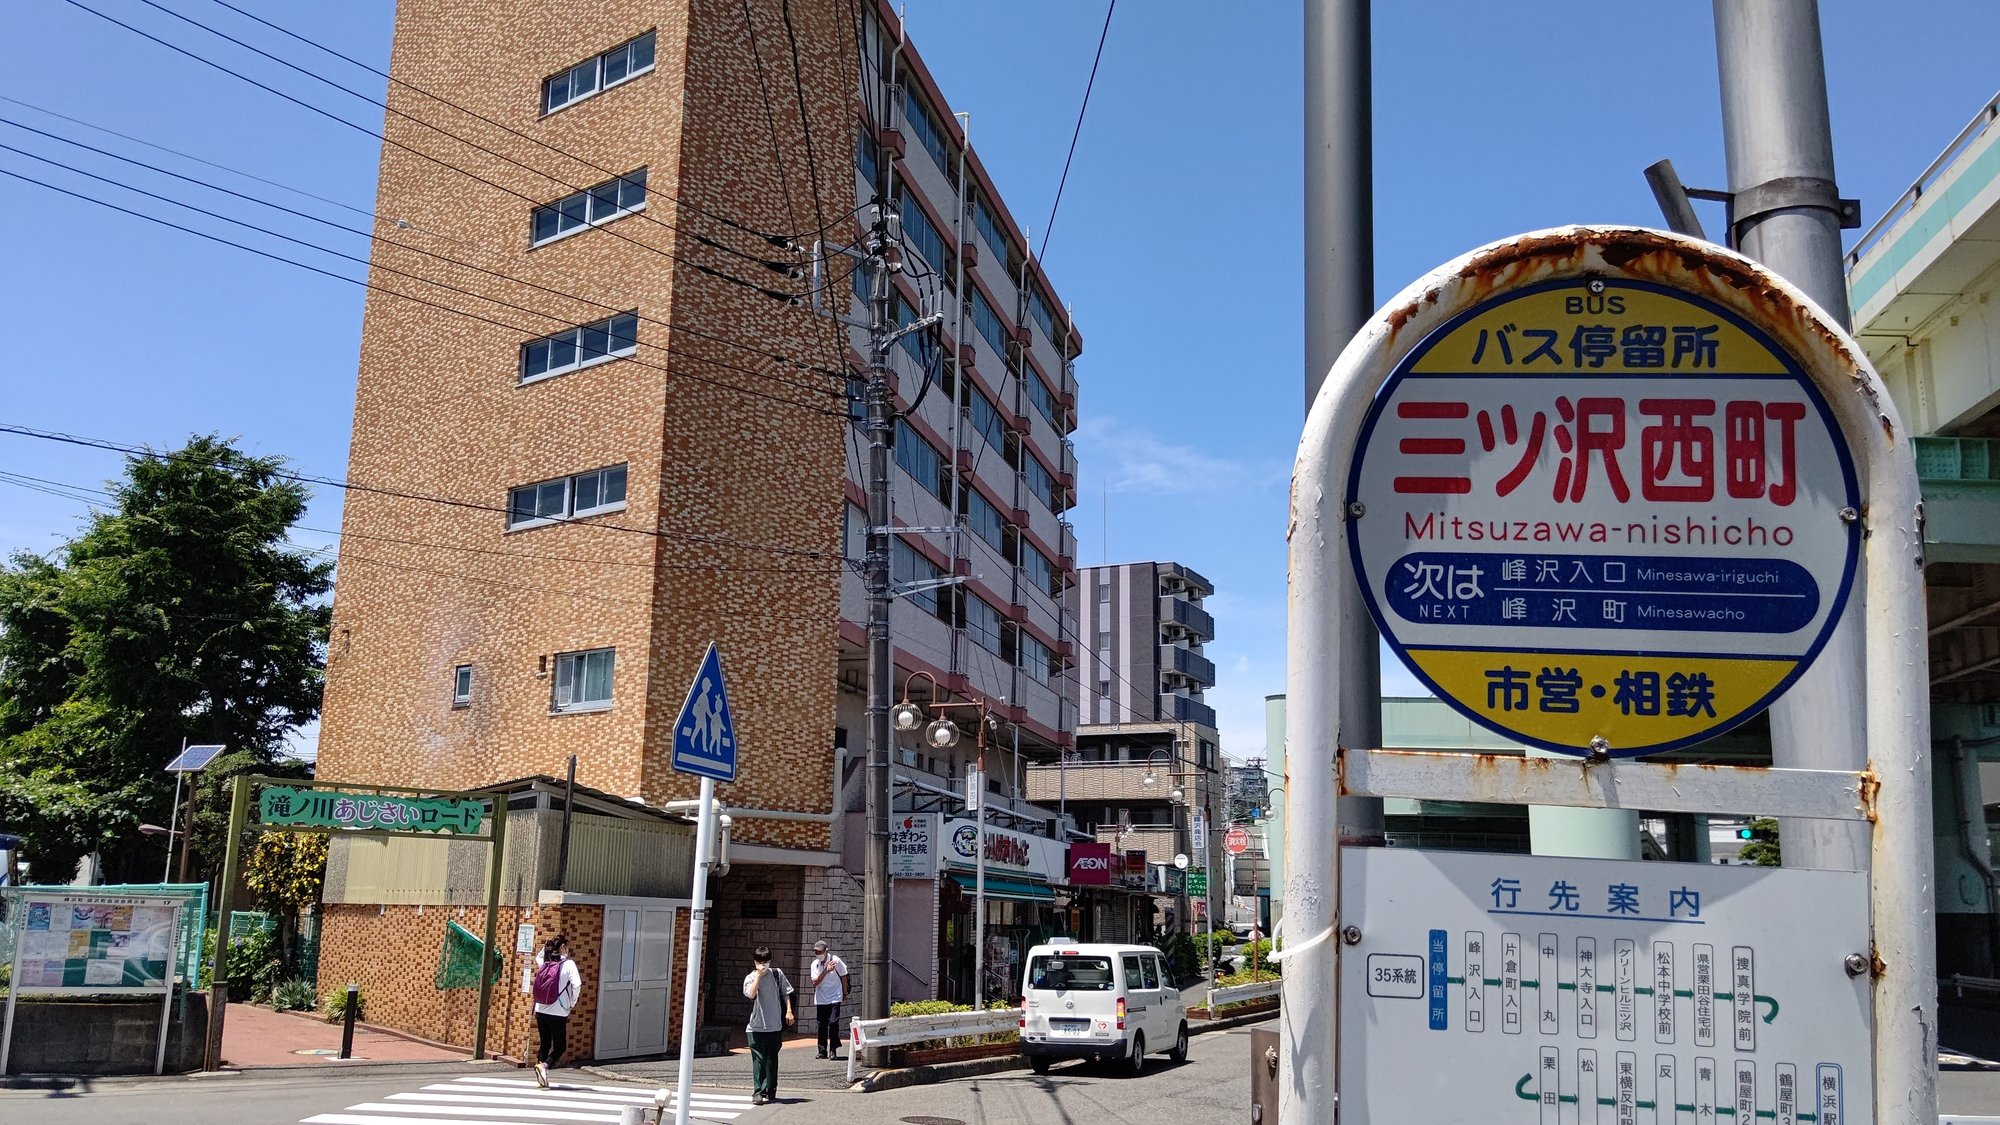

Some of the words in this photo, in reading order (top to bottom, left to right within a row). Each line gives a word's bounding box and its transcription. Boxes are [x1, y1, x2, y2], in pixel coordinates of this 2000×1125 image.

[1565, 295, 1626, 315] BUS
[1471, 323, 1719, 369] バス停留所
[1393, 395, 1806, 506] 三ツ沢西町
[1405, 511, 1794, 546] Mitsuzawa-nishicho
[1403, 560, 1484, 600] 次は
[1502, 559, 1626, 583] 峰沢入口
[1637, 567, 1779, 584] Minesawa-iriguchi
[1419, 604, 1470, 619] NEXT
[1502, 597, 1628, 623] 峰沢町
[1637, 605, 1745, 620] Minesawacho
[1484, 665, 1717, 718] 市営・相鉄
[267, 794, 479, 829] 滝ノ川あじさいロード
[1072, 857, 1108, 870] AEON
[1490, 877, 1700, 917] 行先案内
[1374, 968, 1417, 985] 35系統
[1431, 939, 1445, 1022] 当停留所
[1468, 941, 1482, 1023] 峰沢入口
[1505, 942, 1518, 1025] 片倉町入口
[1542, 946, 1556, 1022] 中丸
[1579, 950, 1593, 1026] 神大寺入口
[1618, 949, 1632, 1031] グリーンヒル三ツ沢
[1656, 952, 1671, 1035] 松本中学校前
[1696, 953, 1711, 1038] 県営栗田谷住宅前
[1736, 956, 1751, 1041] 捜真学院前
[1822, 1076, 1837, 1125] 横浜駅
